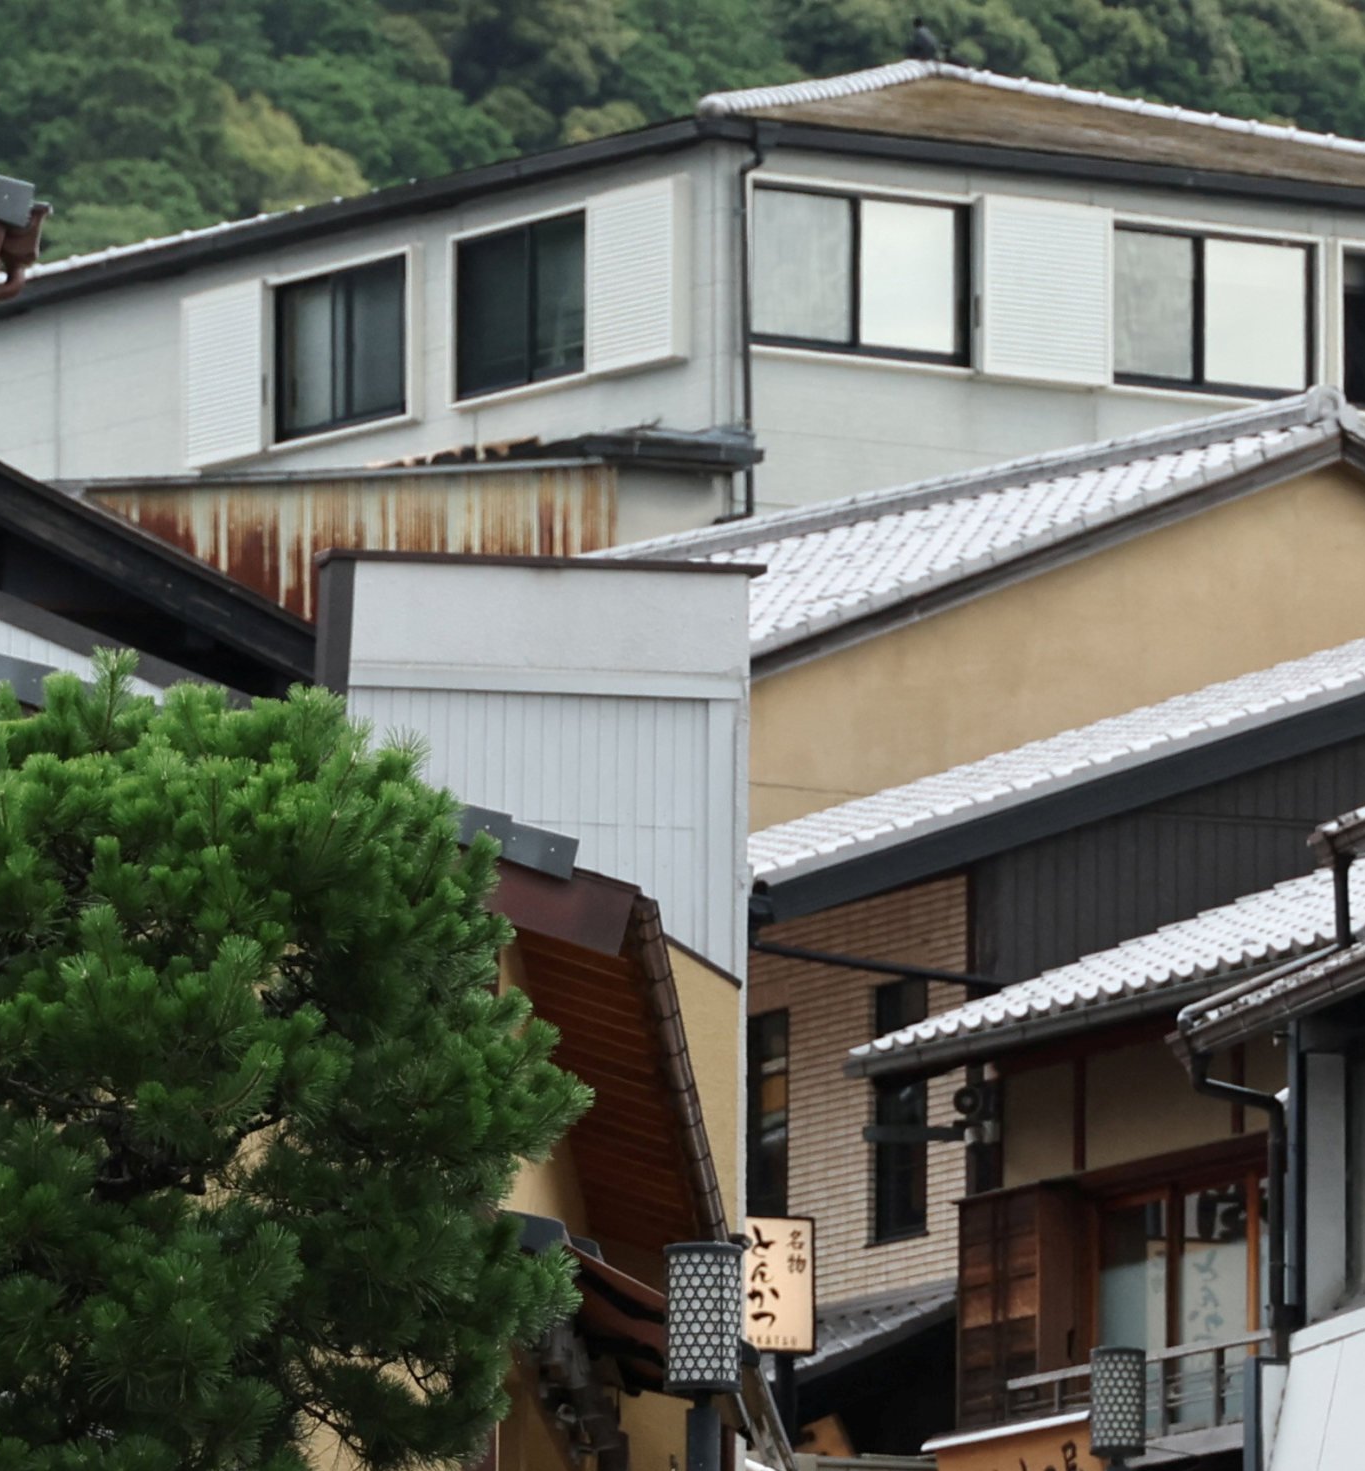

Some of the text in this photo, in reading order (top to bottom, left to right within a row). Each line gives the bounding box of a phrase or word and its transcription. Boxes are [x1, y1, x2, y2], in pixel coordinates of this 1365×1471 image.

[747, 1224, 780, 1329] とんかつ
[786, 1230, 808, 1275] 名物
